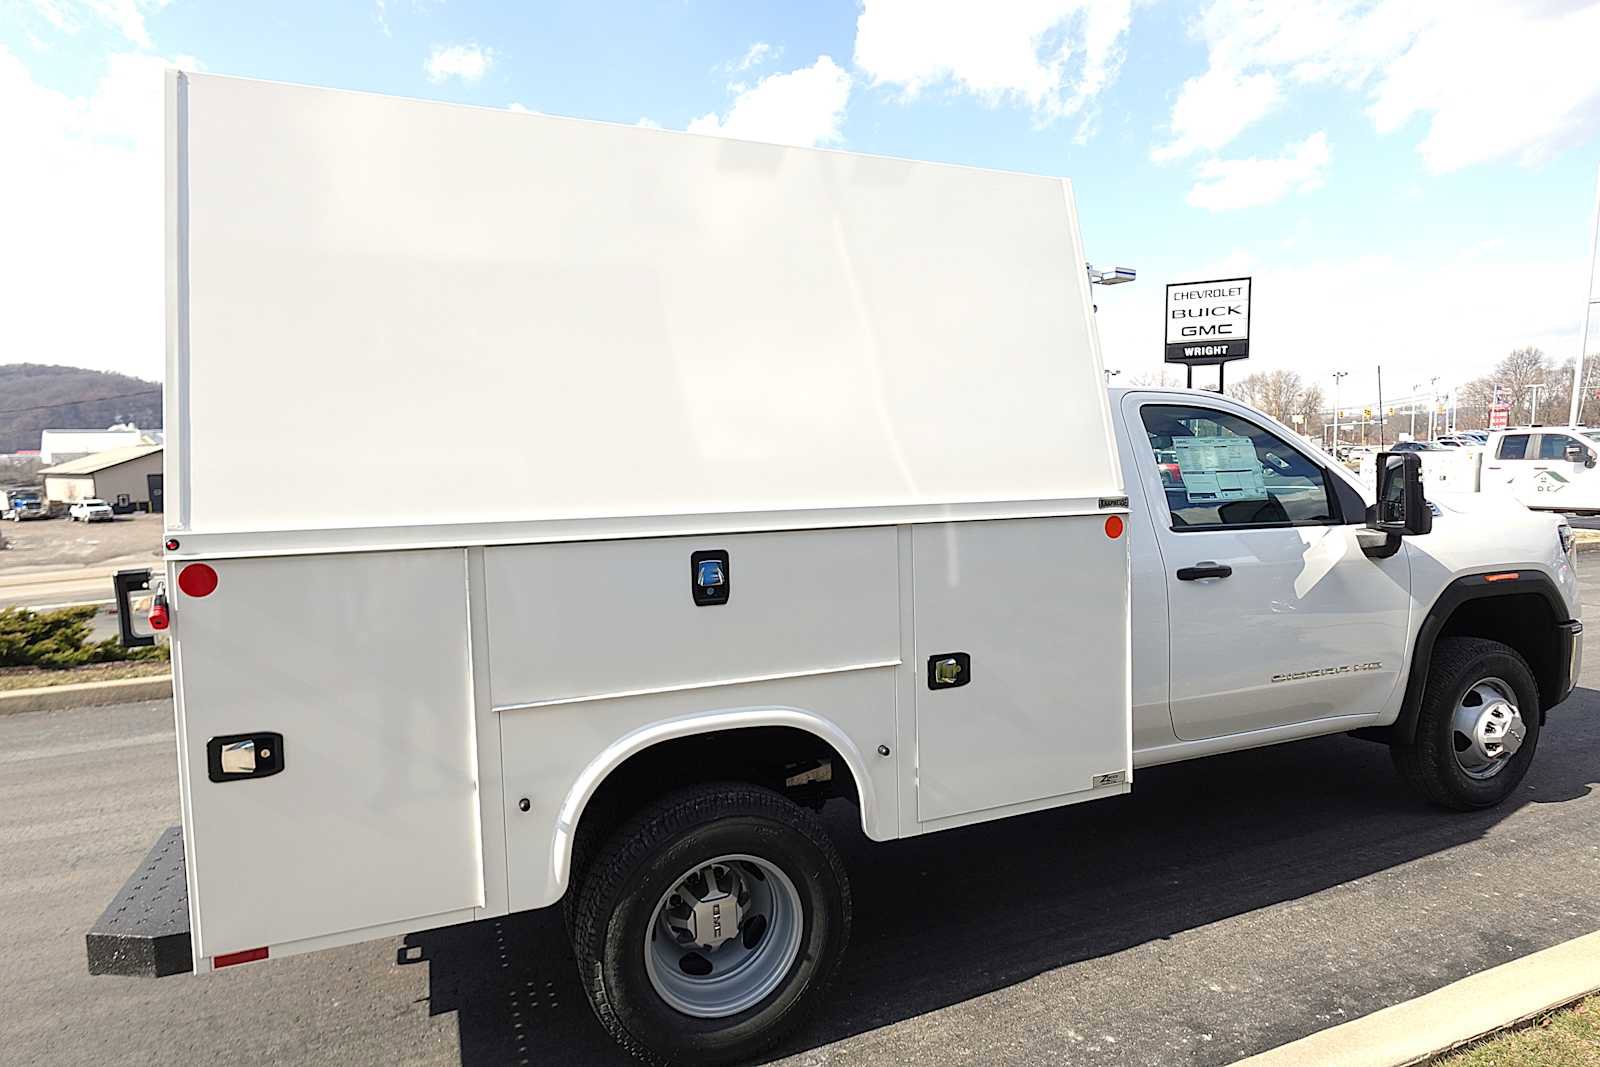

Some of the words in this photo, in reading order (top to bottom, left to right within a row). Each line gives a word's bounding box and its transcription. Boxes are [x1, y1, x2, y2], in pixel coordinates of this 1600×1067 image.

[1174, 287, 1242, 300] CHEVROLET
[1172, 305, 1242, 319] BUICK
[1181, 324, 1233, 336] GMC
[1184, 345, 1229, 357] WRIGHT
